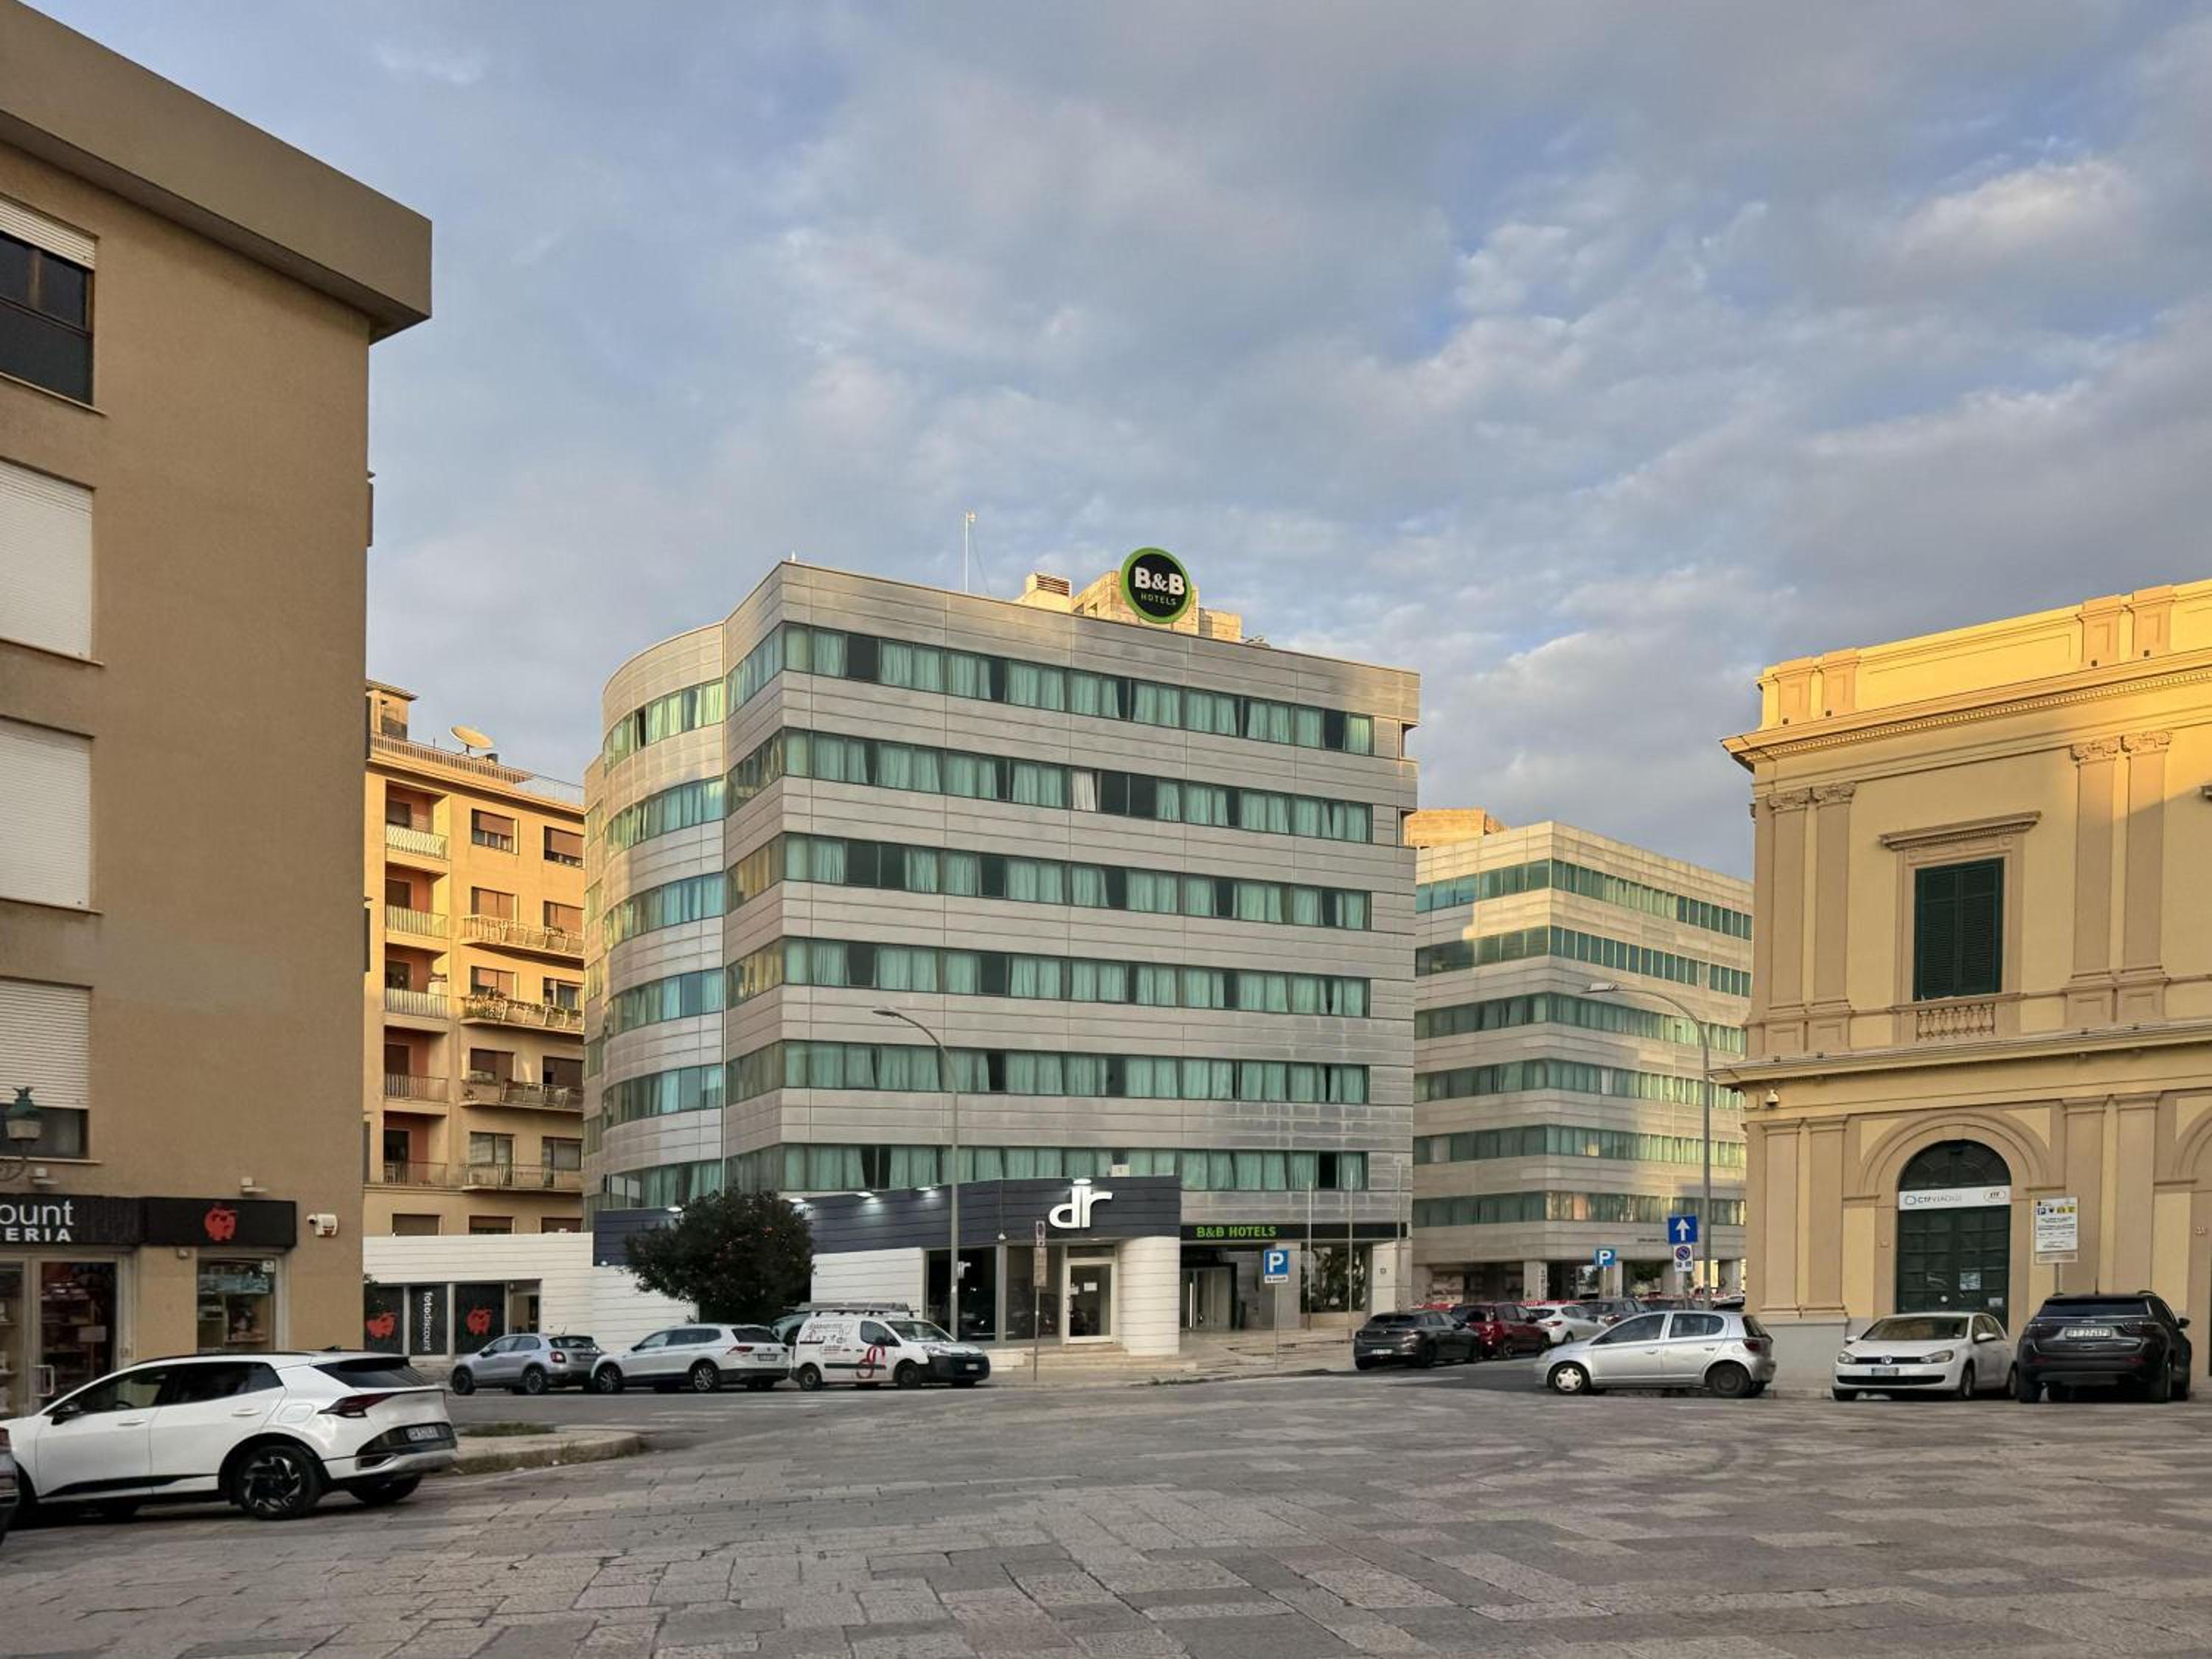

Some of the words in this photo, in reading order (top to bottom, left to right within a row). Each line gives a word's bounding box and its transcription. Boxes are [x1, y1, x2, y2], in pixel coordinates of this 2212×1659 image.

[1135, 567, 1185, 595] B&B
[1141, 592, 1176, 605] HOTELS
[0, 1200, 74, 1225] ount
[5, 1228, 72, 1242] ERIA
[1197, 1226, 1225, 1238] B&B
[1229, 1226, 1276, 1237] HOTELS
[1269, 1253, 1284, 1273] P
[1599, 1250, 1612, 1265] P
[424, 1292, 434, 1351] fotodiscount
